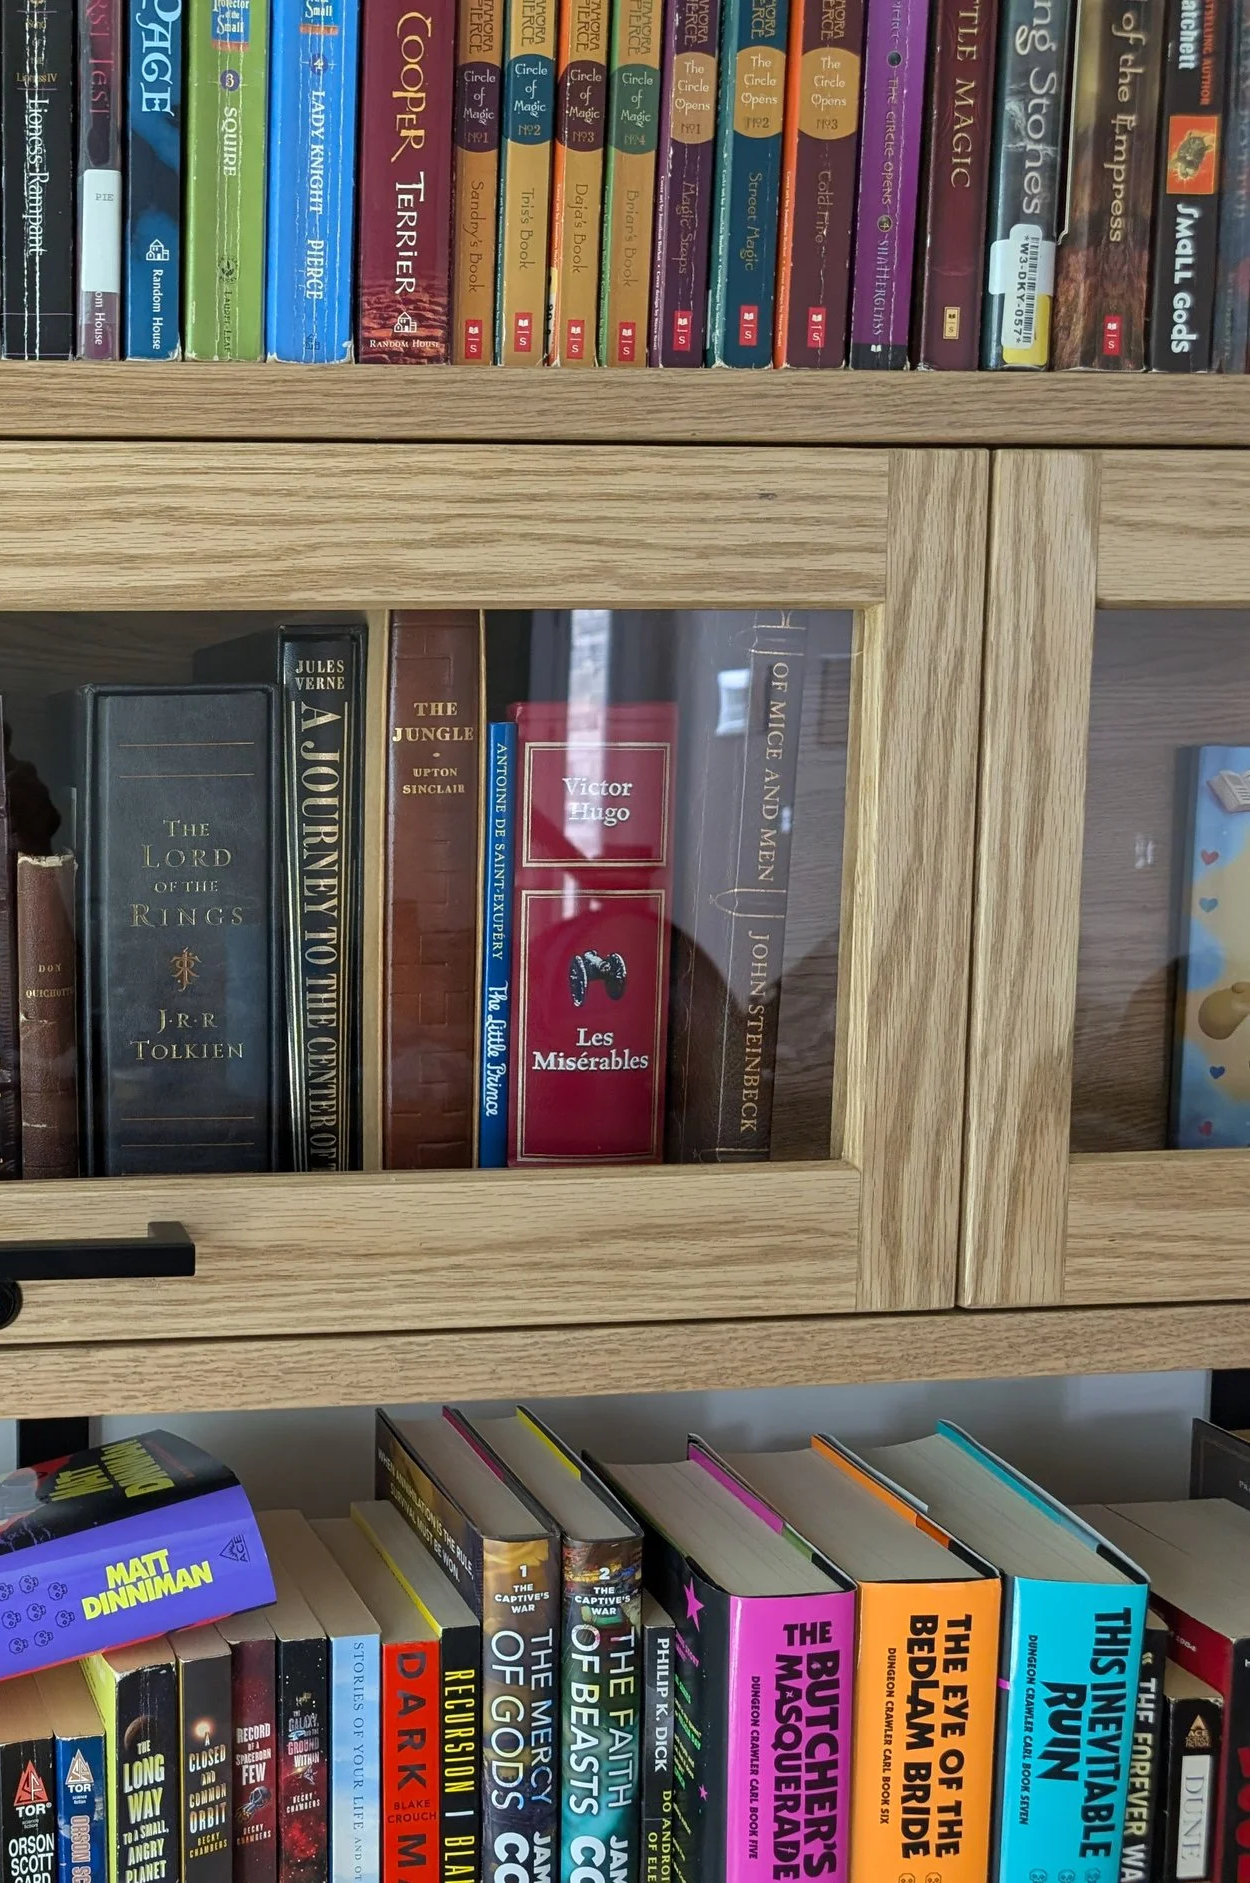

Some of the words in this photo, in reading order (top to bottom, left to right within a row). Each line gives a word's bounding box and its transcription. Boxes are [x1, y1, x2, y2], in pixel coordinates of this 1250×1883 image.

[1112, 13, 1145, 45] of
[464, 71, 496, 84] Circle
[474, 86, 486, 101] of
[1117, 53, 1144, 102] the
[309, 91, 326, 141] LADY
[464, 107, 495, 124] Magic
[222, 106, 237, 177] SQUIRE
[1023, 70, 1058, 214] Stones
[310, 145, 325, 214] KNIGHT
[1104, 115, 1136, 242] Empress
[95, 193, 114, 201] PIE
[519, 188, 535, 227] Tris's
[468, 180, 486, 249] Sandry's
[519, 231, 534, 271] Book
[305, 240, 323, 300] PIERCE
[468, 254, 486, 293] Book
[152, 269, 163, 308] Random
[152, 312, 162, 350] House
[295, 660, 345, 674] JULES
[295, 676, 345, 691] VERNE
[772, 662, 789, 692] OF
[301, 701, 342, 732] A
[414, 702, 458, 716] THE
[392, 728, 474, 743] JUNGLE
[765, 701, 786, 760] MICE
[402, 784, 465, 794] SINCLAIR
[413, 768, 457, 777] UPTON
[496, 743, 508, 813] ANTOINE
[562, 777, 633, 797] Victor
[762, 768, 780, 820] AND
[163, 820, 209, 837] THE
[496, 819, 506, 838] DE
[569, 802, 630, 827] Hugo
[300, 741, 340, 923] JOURNEY
[141, 844, 232, 869] LORD
[758, 828, 776, 881] MEN
[154, 881, 177, 893] OF
[182, 880, 218, 892] THE
[492, 843, 506, 960] SAINT-EXUPÉRY
[130, 903, 244, 927] RINGS
[304, 928, 338, 964] TO
[39, 964, 61, 973] DON
[750, 931, 770, 996] JOHN
[306, 974, 338, 1029] THE
[488, 981, 509, 1011] The
[130, 1040, 244, 1060] TOLKIEN
[486, 1014, 507, 1058] Little
[576, 1028, 614, 1046] Les
[532, 1050, 649, 1071] Misérables
[740, 1005, 764, 1132] STEINBECK
[307, 1037, 338, 1129] CENTER
[485, 1064, 507, 1117] Prince
[309, 1133, 336, 1160] OF
[106, 1548, 170, 1588] MATT
[81, 1560, 213, 1621] DINNIMAN
[495, 1590, 549, 1604] CAPTIVE'S
[514, 1584, 533, 1594] THE
[512, 1603, 535, 1614] WAR
[783, 1621, 832, 1646] THE
[491, 1630, 525, 1686] OF
[530, 1629, 552, 1691] THE
[656, 1637, 669, 1699] PHILIP
[354, 1641, 364, 1712] STORIES
[354, 1718, 364, 1737] OF
[656, 1704, 668, 1721] K.
[205, 1732, 210, 1746] A
[444, 1668, 475, 1794] RECURSION
[189, 1745, 227, 1773] CLOSED
[354, 1742, 364, 1790] YOUR
[490, 1697, 525, 1811] GODS
[529, 1700, 552, 1804] MERCY
[655, 1727, 668, 1773] DICK
[803, 1650, 840, 1877] BUTCHER'S
[202, 1771, 216, 1786] AND
[772, 1654, 803, 1881] MASQUERADE
[189, 1782, 227, 1809] COMMON
[189, 1802, 227, 1834] ORBIT
[354, 1796, 364, 1830] LIFE
[189, 1838, 227, 1859] CHAMBERS
[197, 1831, 220, 1848] BECKY
[354, 1837, 362, 1861] AND
